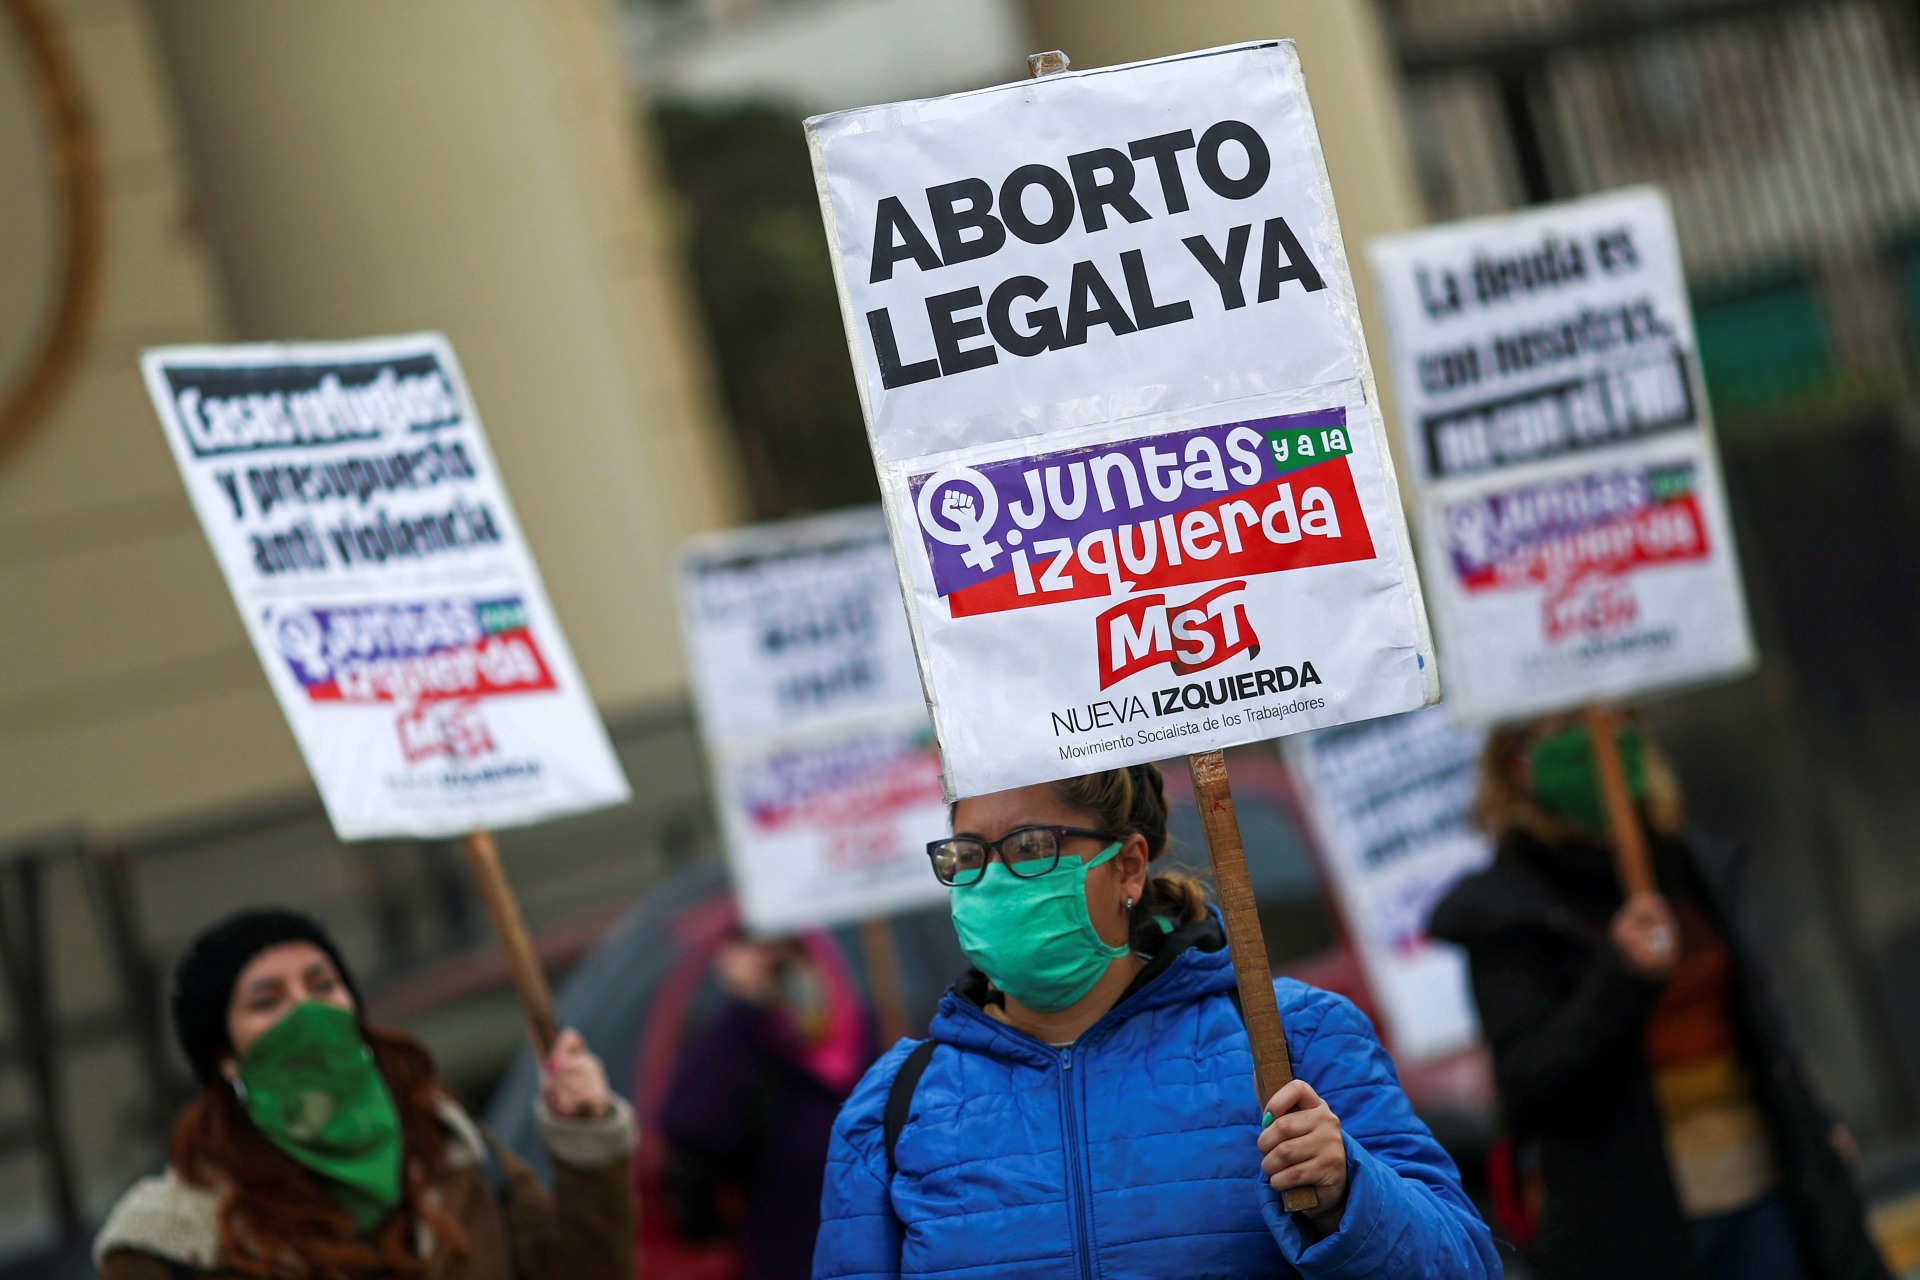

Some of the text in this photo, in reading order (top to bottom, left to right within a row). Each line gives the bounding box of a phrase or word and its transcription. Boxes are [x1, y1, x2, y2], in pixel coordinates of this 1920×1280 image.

[869, 120, 1270, 284] ABORTO
[866, 216, 1328, 390] LEGAL YA
[1415, 226, 1639, 321] La deuda es
[1417, 341, 1481, 394] con
[247, 440, 476, 517] presupuesto
[1272, 438, 1289, 462] y
[1297, 434, 1316, 457] a
[1320, 429, 1348, 453] la
[249, 493, 503, 575] anti violencia
[1109, 589, 1247, 674] MST
[1051, 660, 1323, 737] NUEVA IZQUIERDA
[1059, 696, 1325, 761] Movimiento Socialista de los Trabajadores
